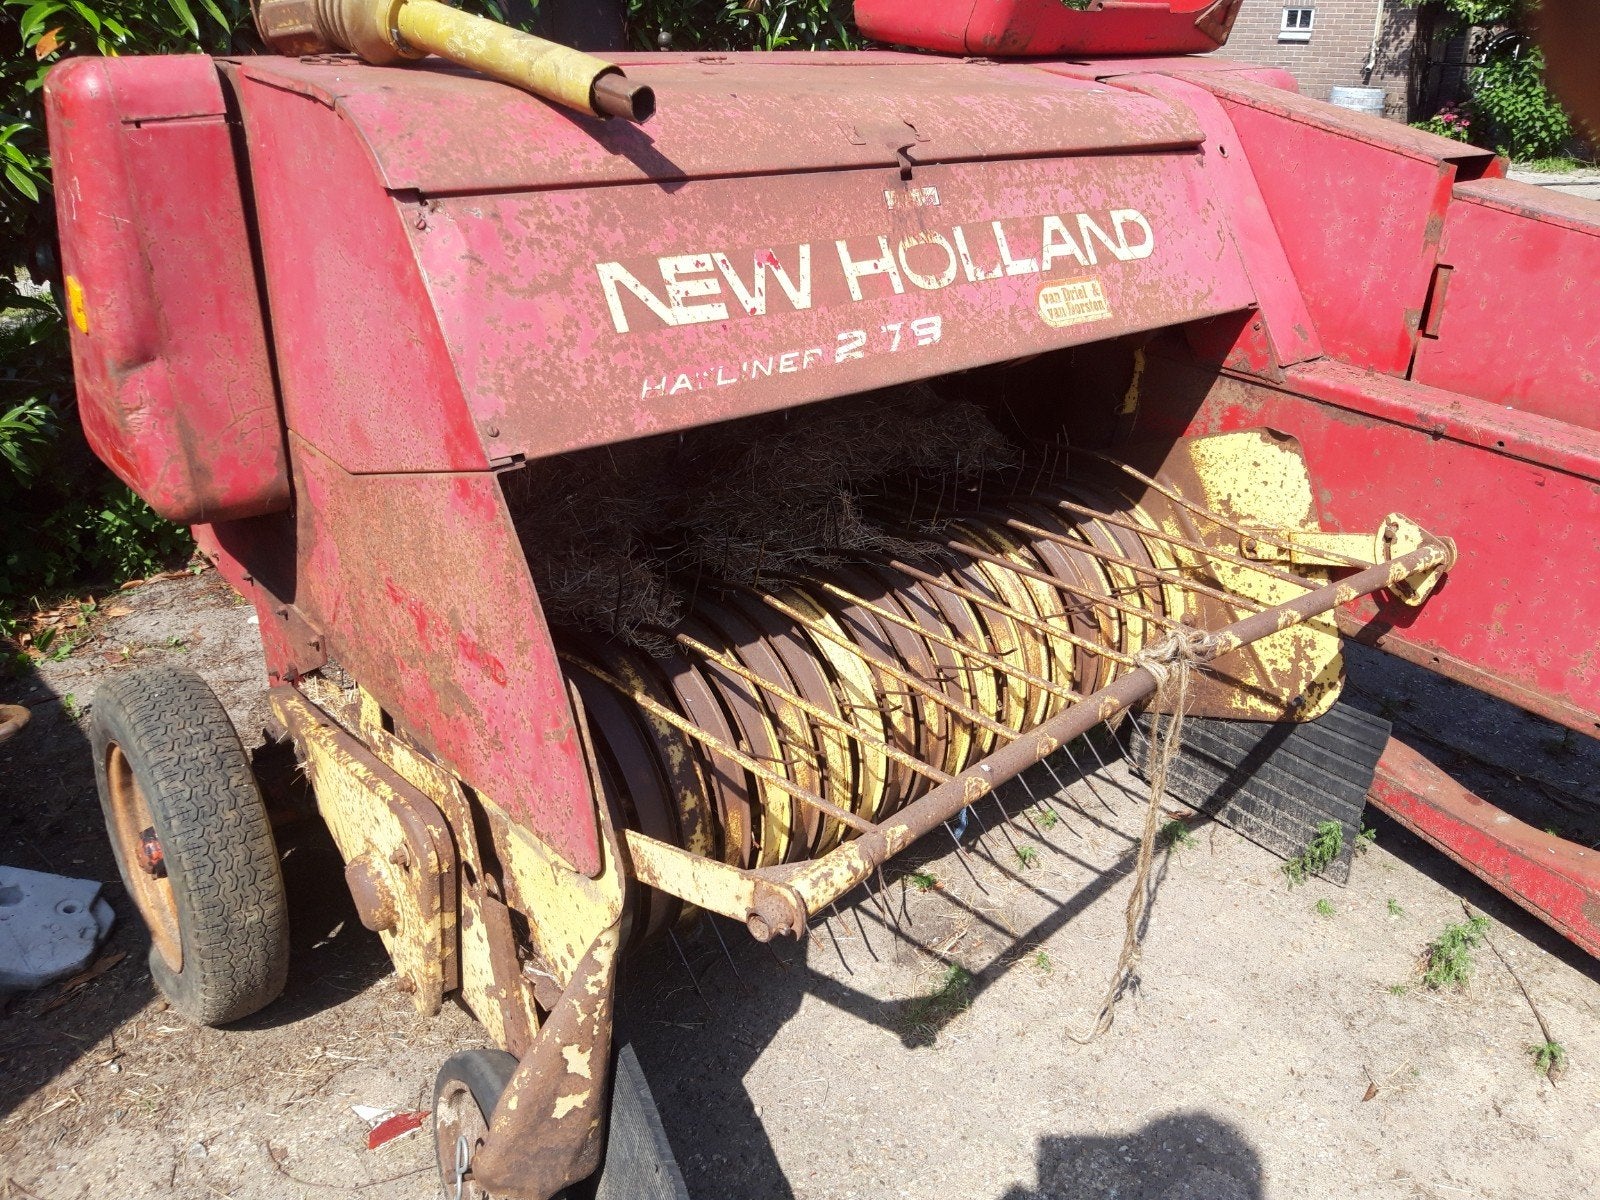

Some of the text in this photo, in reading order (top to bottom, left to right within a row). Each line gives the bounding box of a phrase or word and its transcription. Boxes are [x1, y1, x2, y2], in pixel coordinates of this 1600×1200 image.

[596, 208, 1154, 333] NEW HOLLAND
[1042, 283, 1101, 304] van Driel &
[1047, 306, 1067, 319] van
[834, 315, 943, 363] 279
